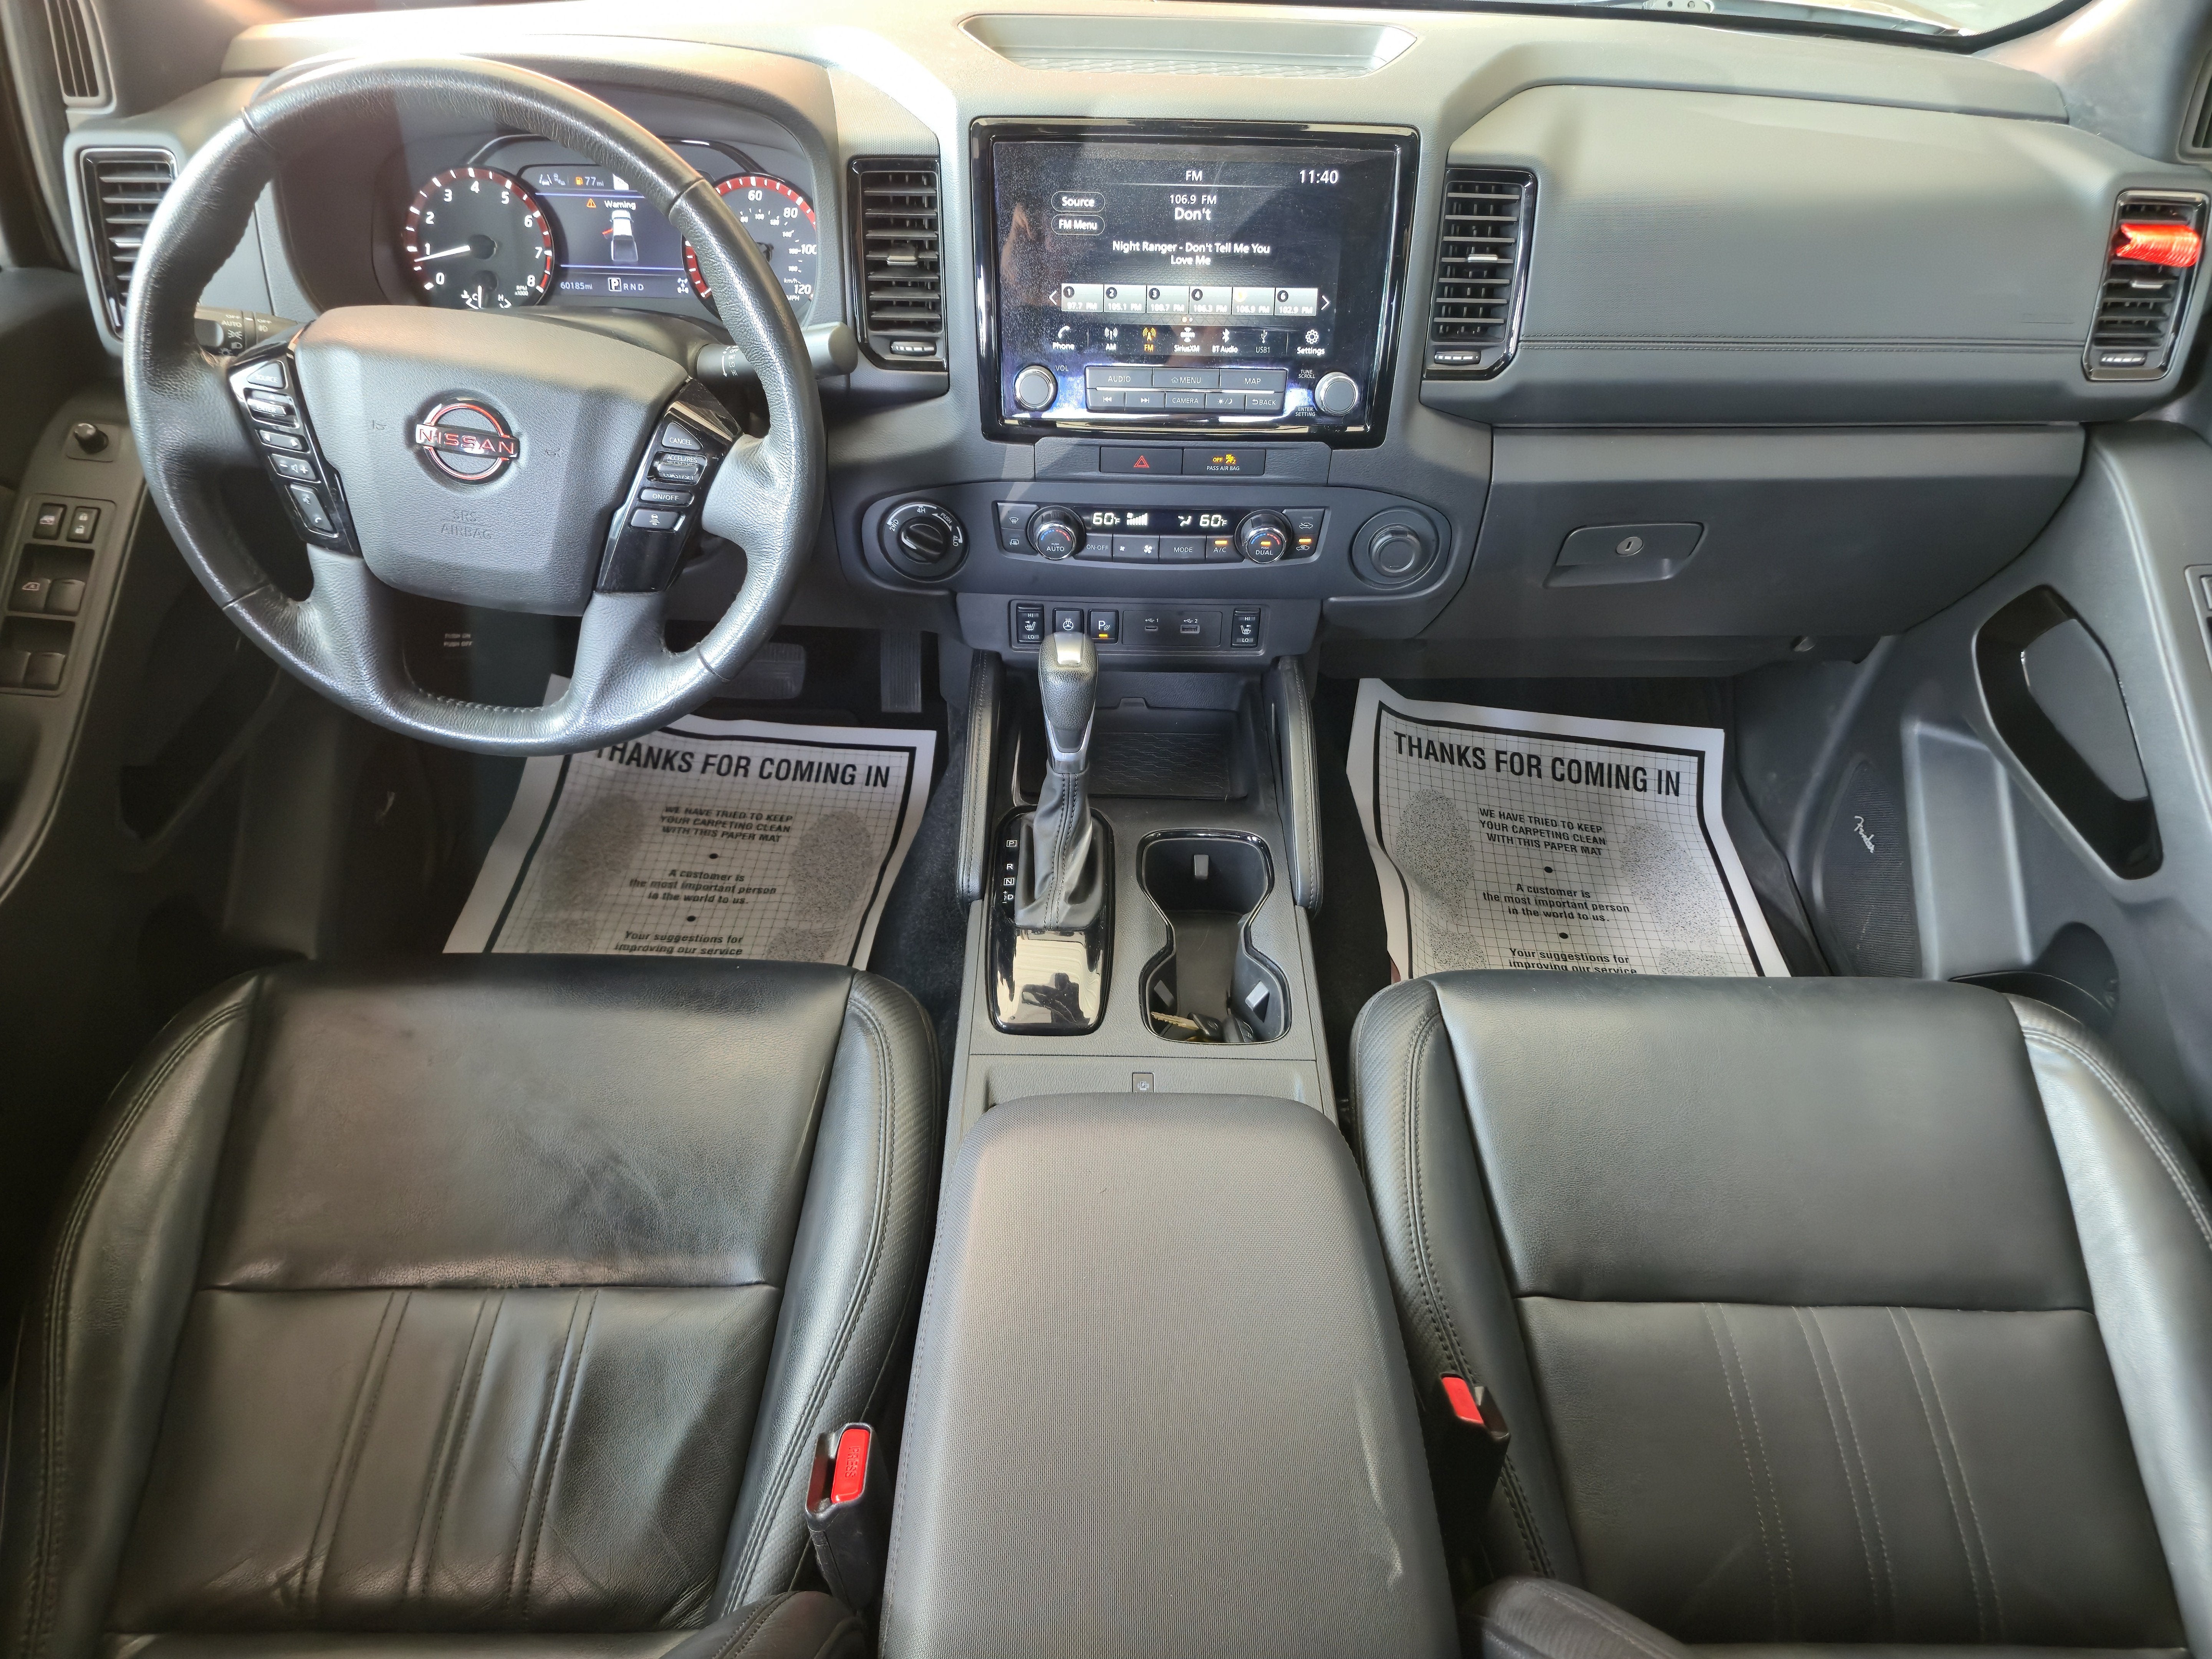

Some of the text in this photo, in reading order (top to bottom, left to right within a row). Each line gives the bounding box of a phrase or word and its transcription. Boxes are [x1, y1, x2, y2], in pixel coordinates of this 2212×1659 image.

[1185, 171, 1202, 181] FM
[1299, 170, 1338, 184] 11:40
[470, 181, 480, 193] 4
[444, 189, 452, 202] 3
[502, 192, 510, 204] 5
[748, 190, 762, 201] 60
[1169, 195, 1217, 205] 106.9 FM
[604, 200, 636, 210] Warning
[1061, 197, 1095, 207] Source
[426, 212, 434, 224] 2
[783, 207, 798, 218] 80
[1174, 208, 1211, 220] Don't
[524, 215, 533, 228] 6
[1058, 219, 1097, 230] FM Menu
[425, 243, 430, 255] 1
[535, 247, 543, 258] 7
[1113, 241, 1140, 253] Night
[1142, 242, 1177, 254] Ranger
[1185, 243, 1212, 253] Don't
[1214, 243, 1230, 253] Tell
[1233, 243, 1249, 253] Me
[1251, 243, 1270, 254] You
[1171, 255, 1211, 265] Love Me
[436, 272, 445, 285] 0
[527, 275, 535, 287] 8
[612, 280, 619, 289] P
[794, 284, 811, 295] 120
[1067, 288, 1071, 296] 1
[1109, 289, 1114, 297] 2
[1195, 291, 1200, 299] 4
[1280, 292, 1286, 300] 6
[1052, 342, 1075, 350] Phone
[1144, 344, 1154, 352] FM
[1296, 346, 1326, 356] Settings
[419, 428, 514, 455] NISSAN
[669, 437, 692, 445] CANCEL
[667, 454, 697, 463] ACCEL/RES
[453, 509, 477, 522] SRS
[940, 512, 952, 523] PUSH
[441, 523, 494, 540] AIRBAG
[889, 519, 899, 532] 2WD
[1098, 620, 1105, 630] P
[1394, 731, 1681, 797] THANKS FOR COMING IN
[700, 753, 752, 778] FOR
[758, 757, 857, 785] COMING
[865, 765, 890, 788] IN
[1479, 807, 1603, 834] WE HAVE TRIED TO KEEP
[1479, 819, 1607, 845] YOUR CARPETING CLEAN
[1488, 832, 1603, 857] WITH THIS PAPER MAT
[1516, 883, 1591, 899] A customer is
[1483, 891, 1630, 913] the most important person
[1508, 906, 1518, 915] in
[1522, 907, 1540, 917] the
[1543, 909, 1575, 920] world
[1592, 914, 1610, 922] us.
[625, 930, 743, 944] Your suggestions for
[614, 941, 743, 955] improving our service
[1509, 948, 1629, 964] Your suggestions for
[844, 1446, 860, 1478] PRESS
